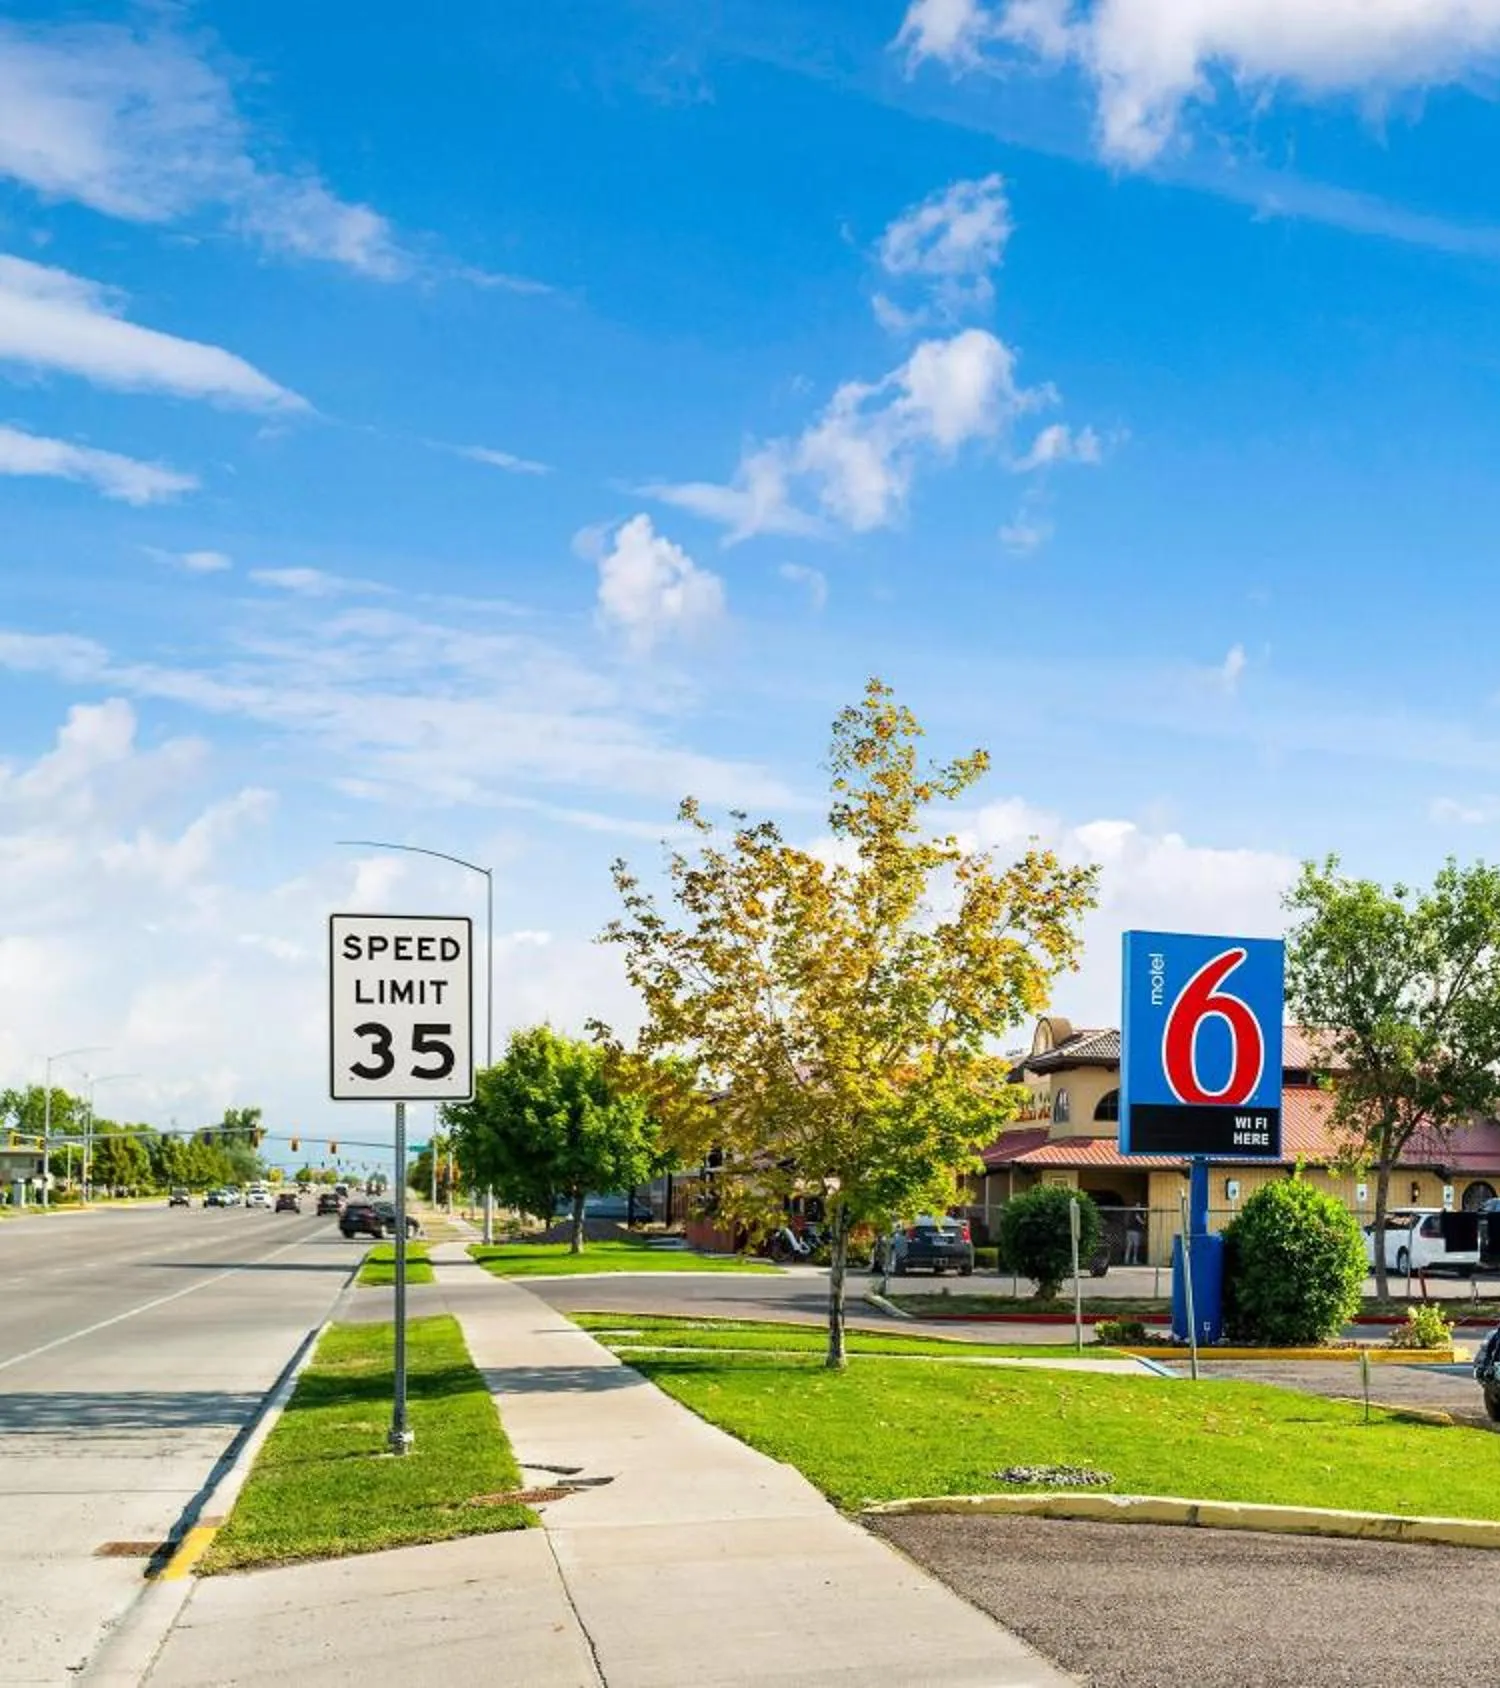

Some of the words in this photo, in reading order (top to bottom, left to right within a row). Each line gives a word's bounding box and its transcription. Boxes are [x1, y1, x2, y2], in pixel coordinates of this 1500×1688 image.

[342, 934, 461, 962] SPEED
[355, 979, 449, 1005] LIMIT
[1148, 953, 1165, 1006] motel
[1162, 947, 1265, 1106] 6
[349, 1022, 456, 1081] 35
[1235, 1116, 1251, 1129] WI
[1255, 1117, 1267, 1130] FI
[1234, 1131, 1269, 1146] HERE
